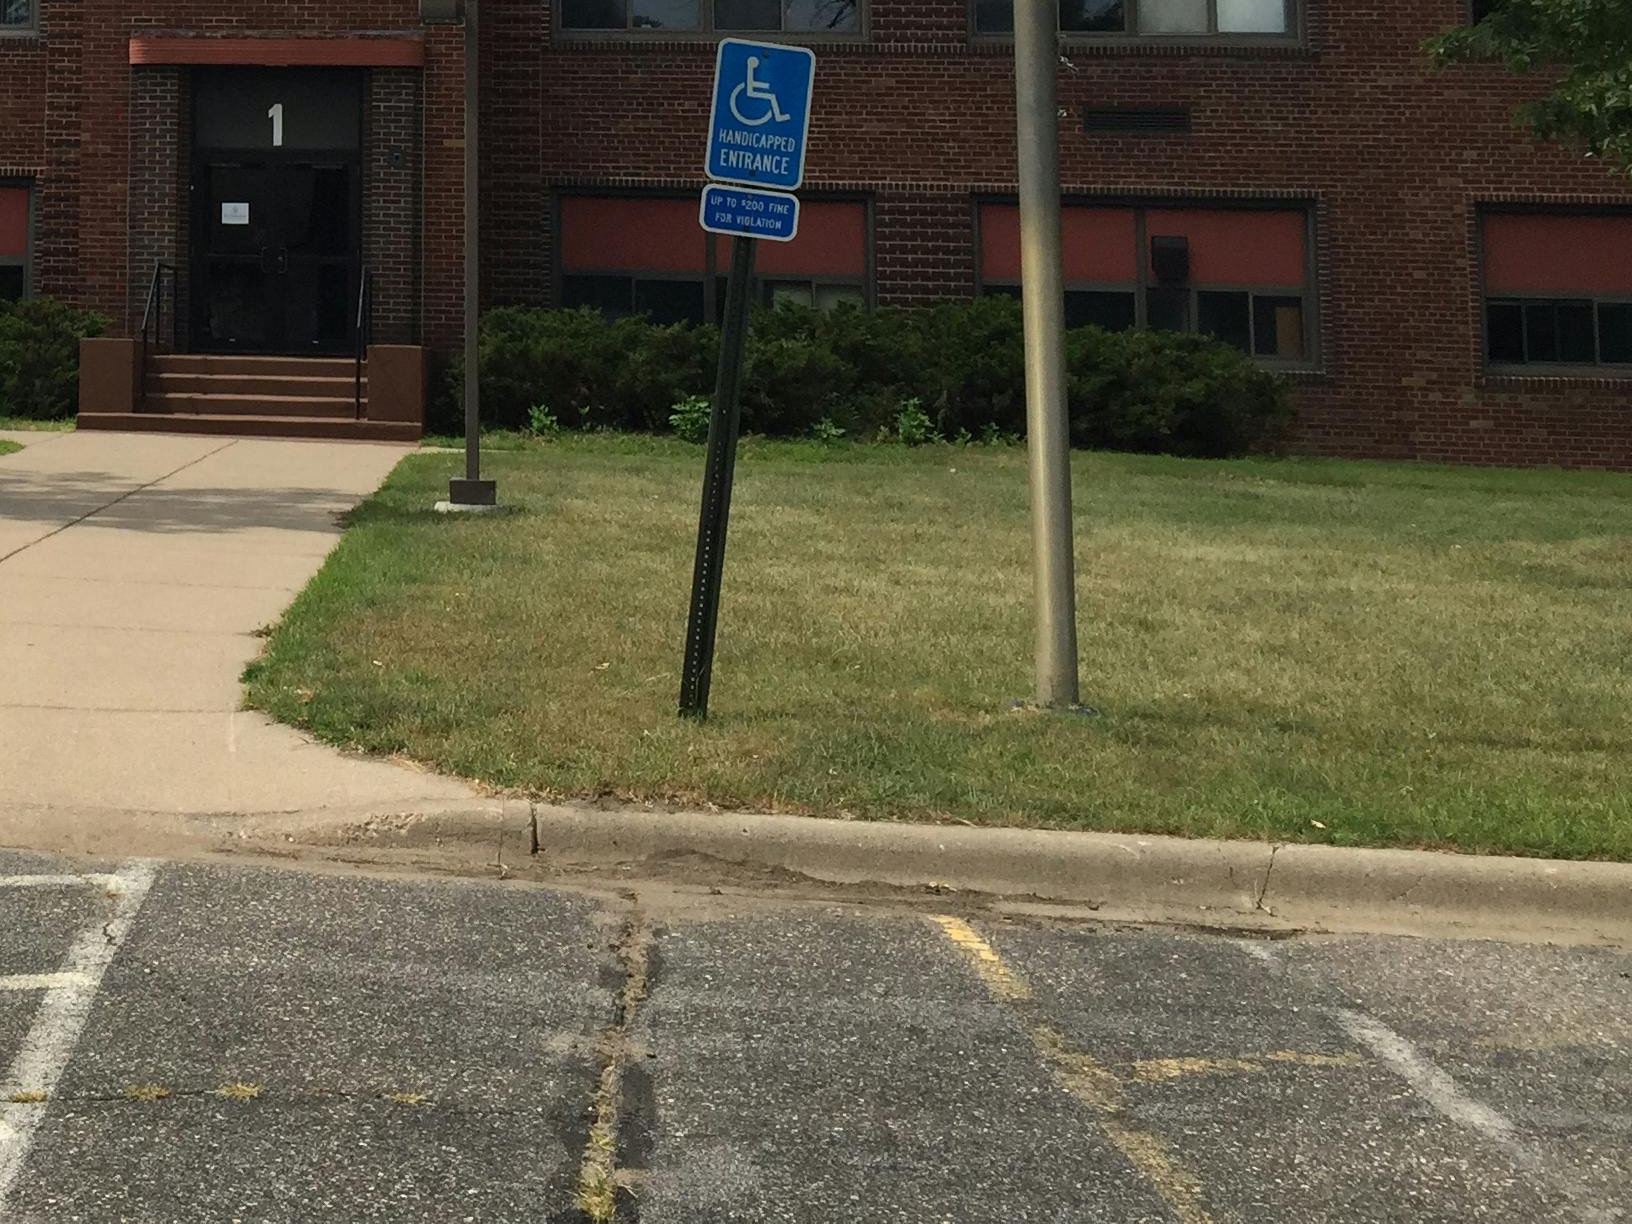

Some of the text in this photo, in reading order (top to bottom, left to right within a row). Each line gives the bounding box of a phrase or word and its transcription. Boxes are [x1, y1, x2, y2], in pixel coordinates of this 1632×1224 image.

[268, 103, 283, 147] 1
[718, 128, 795, 153] HANDICAPPED
[719, 148, 790, 175] ENTRANCE
[710, 195, 789, 214] UP TO $200 FINE
[714, 212, 782, 230] FOR VIOLATION
